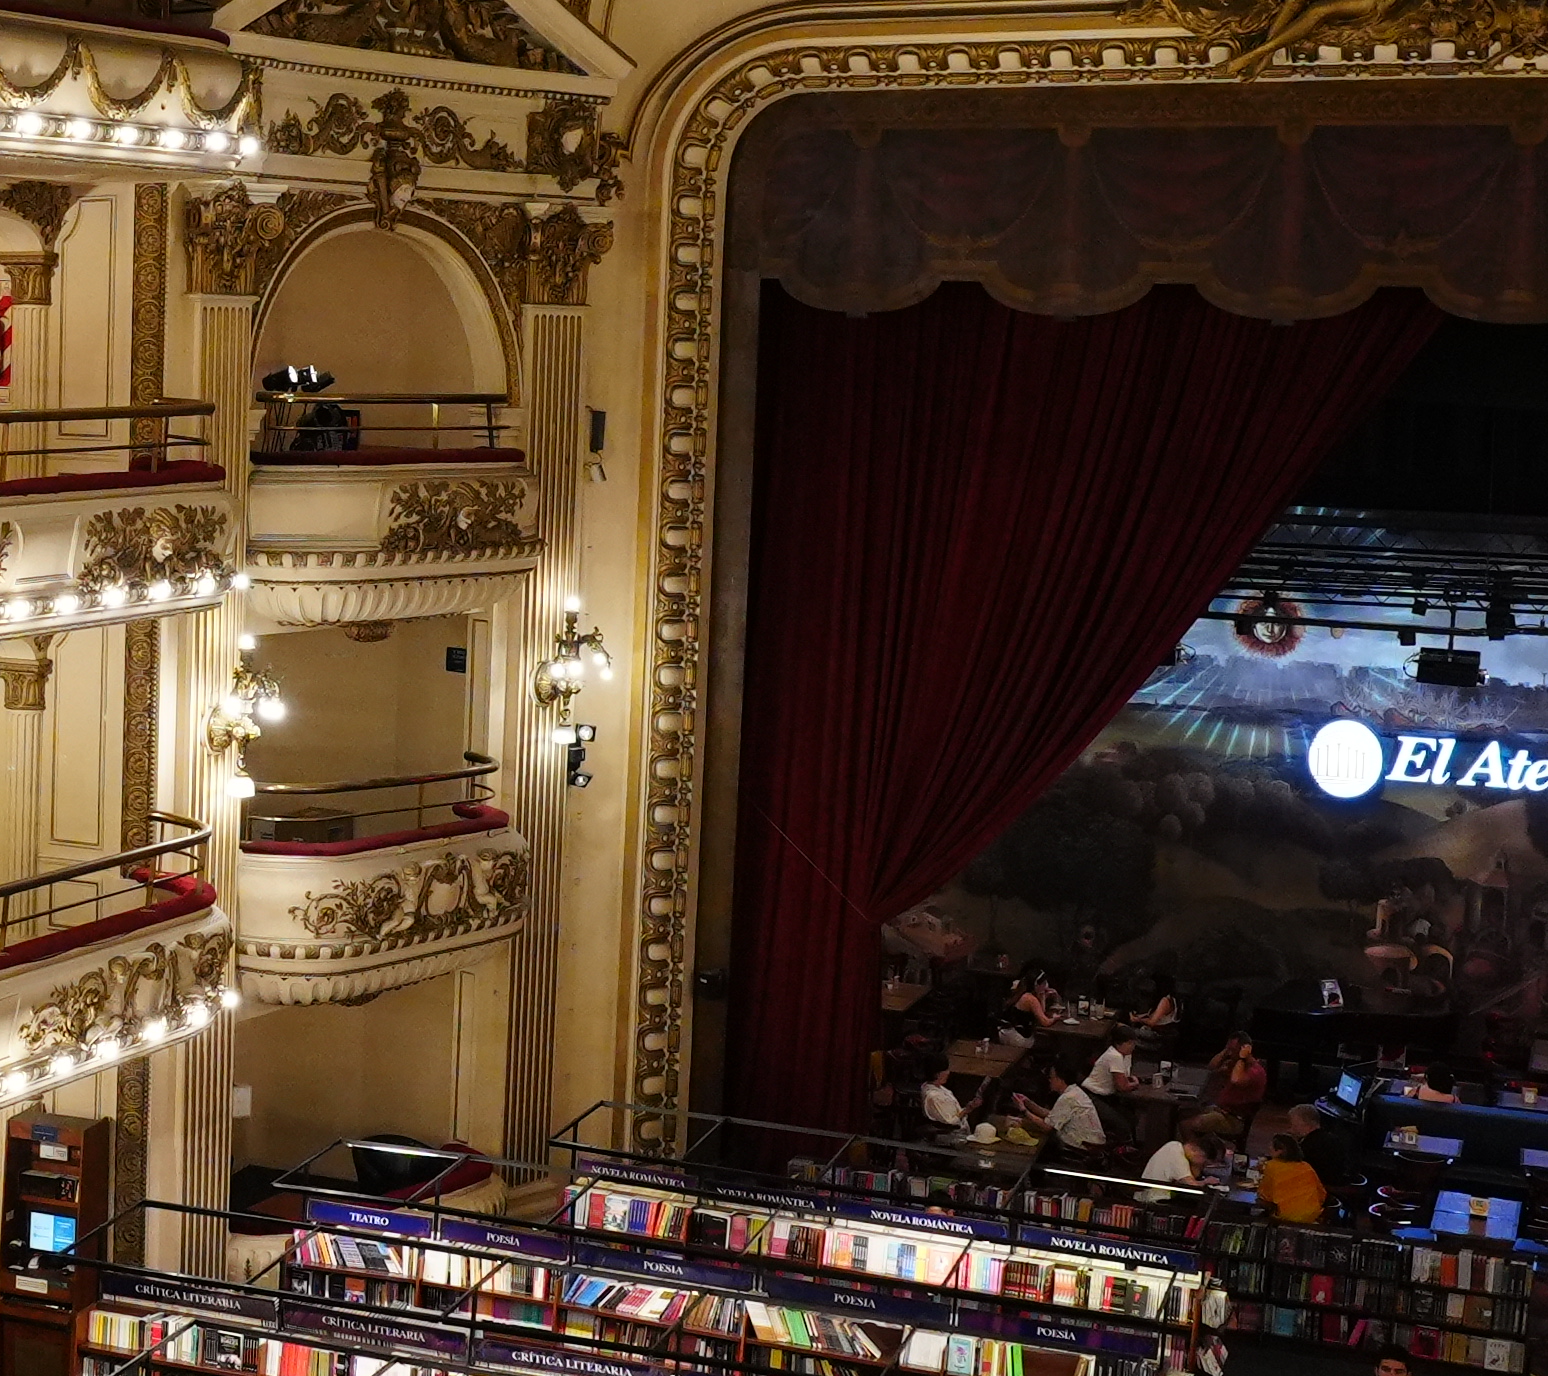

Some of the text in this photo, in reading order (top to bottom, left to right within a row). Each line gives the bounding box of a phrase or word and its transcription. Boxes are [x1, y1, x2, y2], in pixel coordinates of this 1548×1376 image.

[1385, 735, 1451, 784] El
[591, 1165, 686, 1189] NOVELA ROMÁNTICA
[349, 1211, 389, 1227] TEATRO
[870, 1209, 973, 1235] NOVELA ROMÁNTICA
[486, 1230, 520, 1247] POESÍA
[1051, 1236, 1169, 1265] NOVELA ROMÁNTICA
[135, 1283, 242, 1312] CRÍTICA LITERARIA
[322, 1315, 425, 1343] CRÍTICA LITERARIA
[1037, 1325, 1076, 1341] POESÍA
[511, 1350, 562, 1367] CRÍTICA
